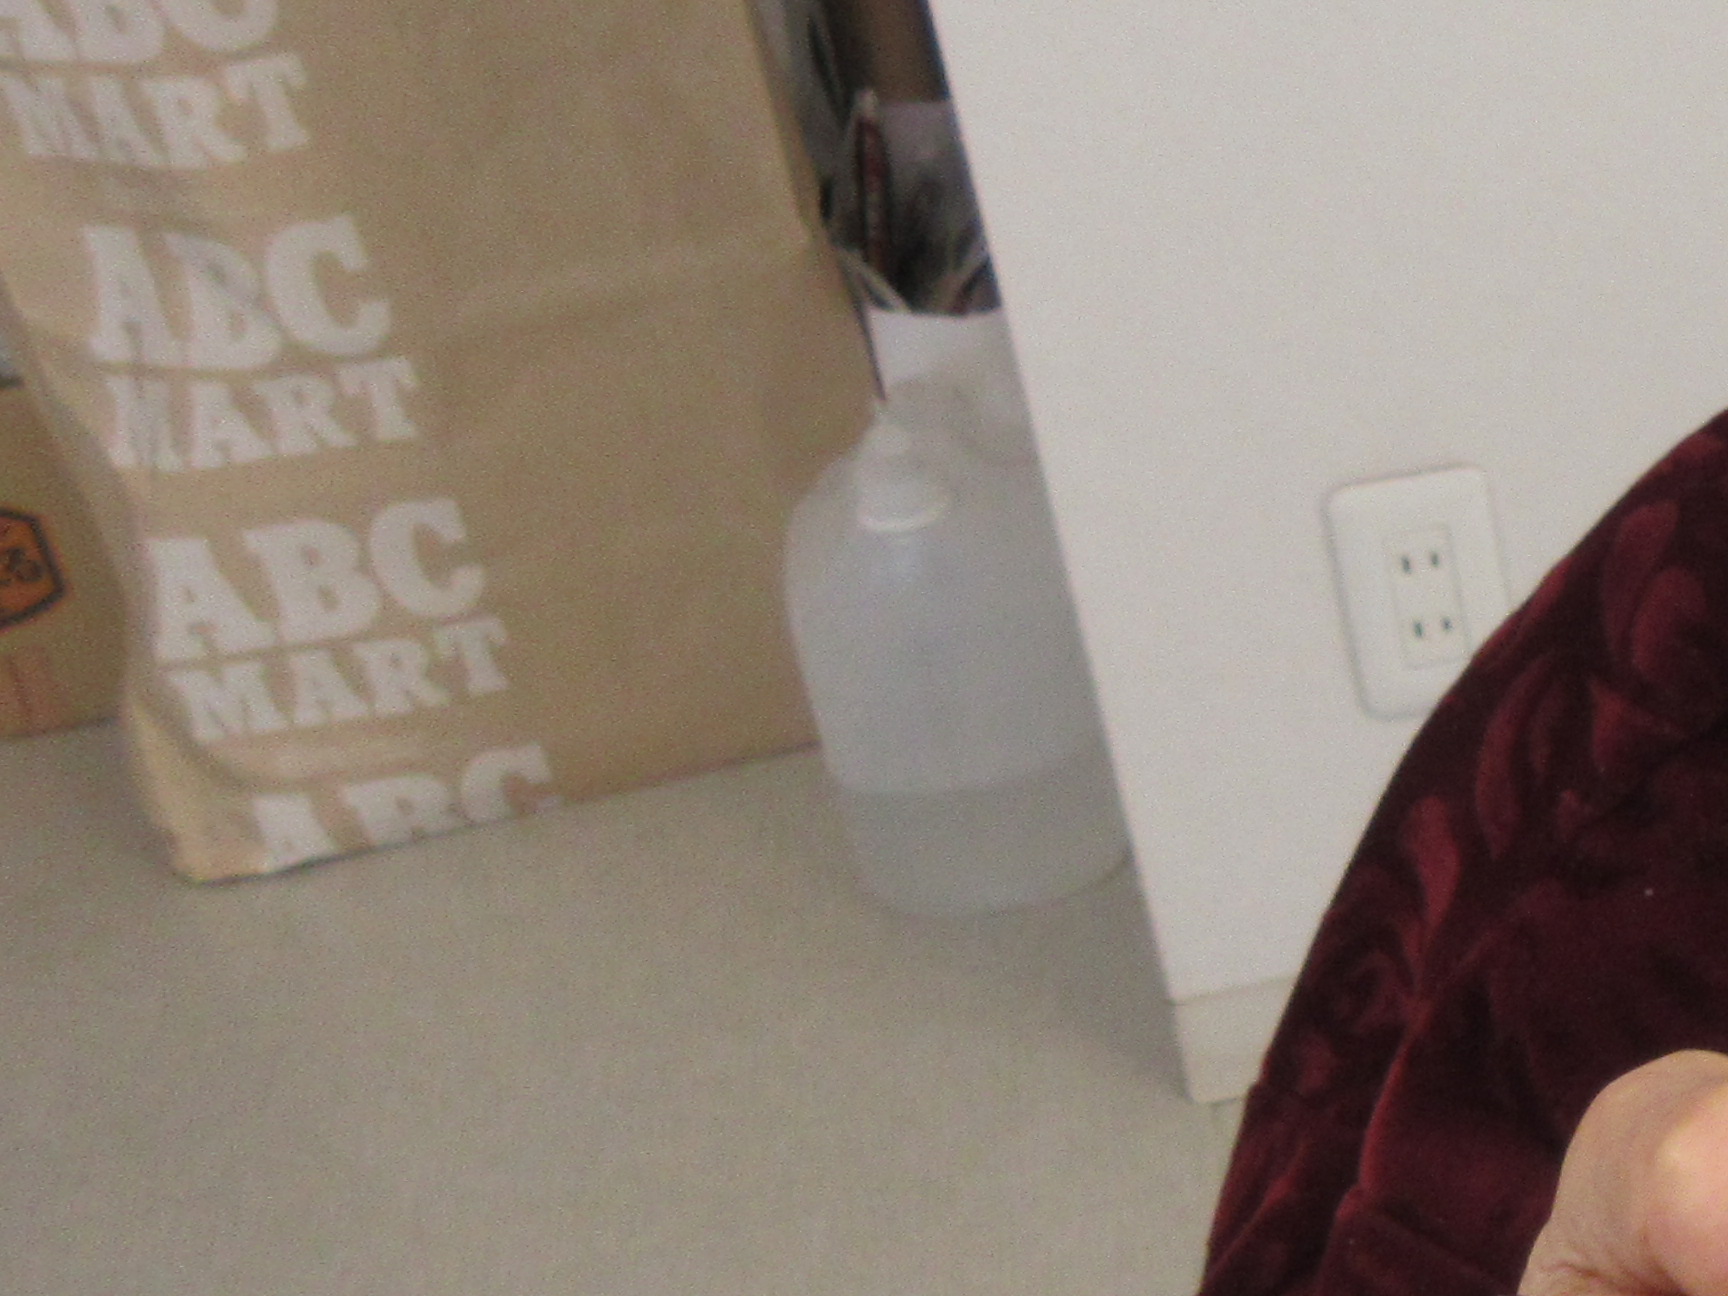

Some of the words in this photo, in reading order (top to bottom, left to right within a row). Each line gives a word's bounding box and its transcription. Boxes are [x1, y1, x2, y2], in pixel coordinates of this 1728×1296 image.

[0, 53, 308, 168] MART
[83, 214, 393, 370] ABC
[148, 498, 488, 664] ABC
[168, 614, 510, 744] MART
